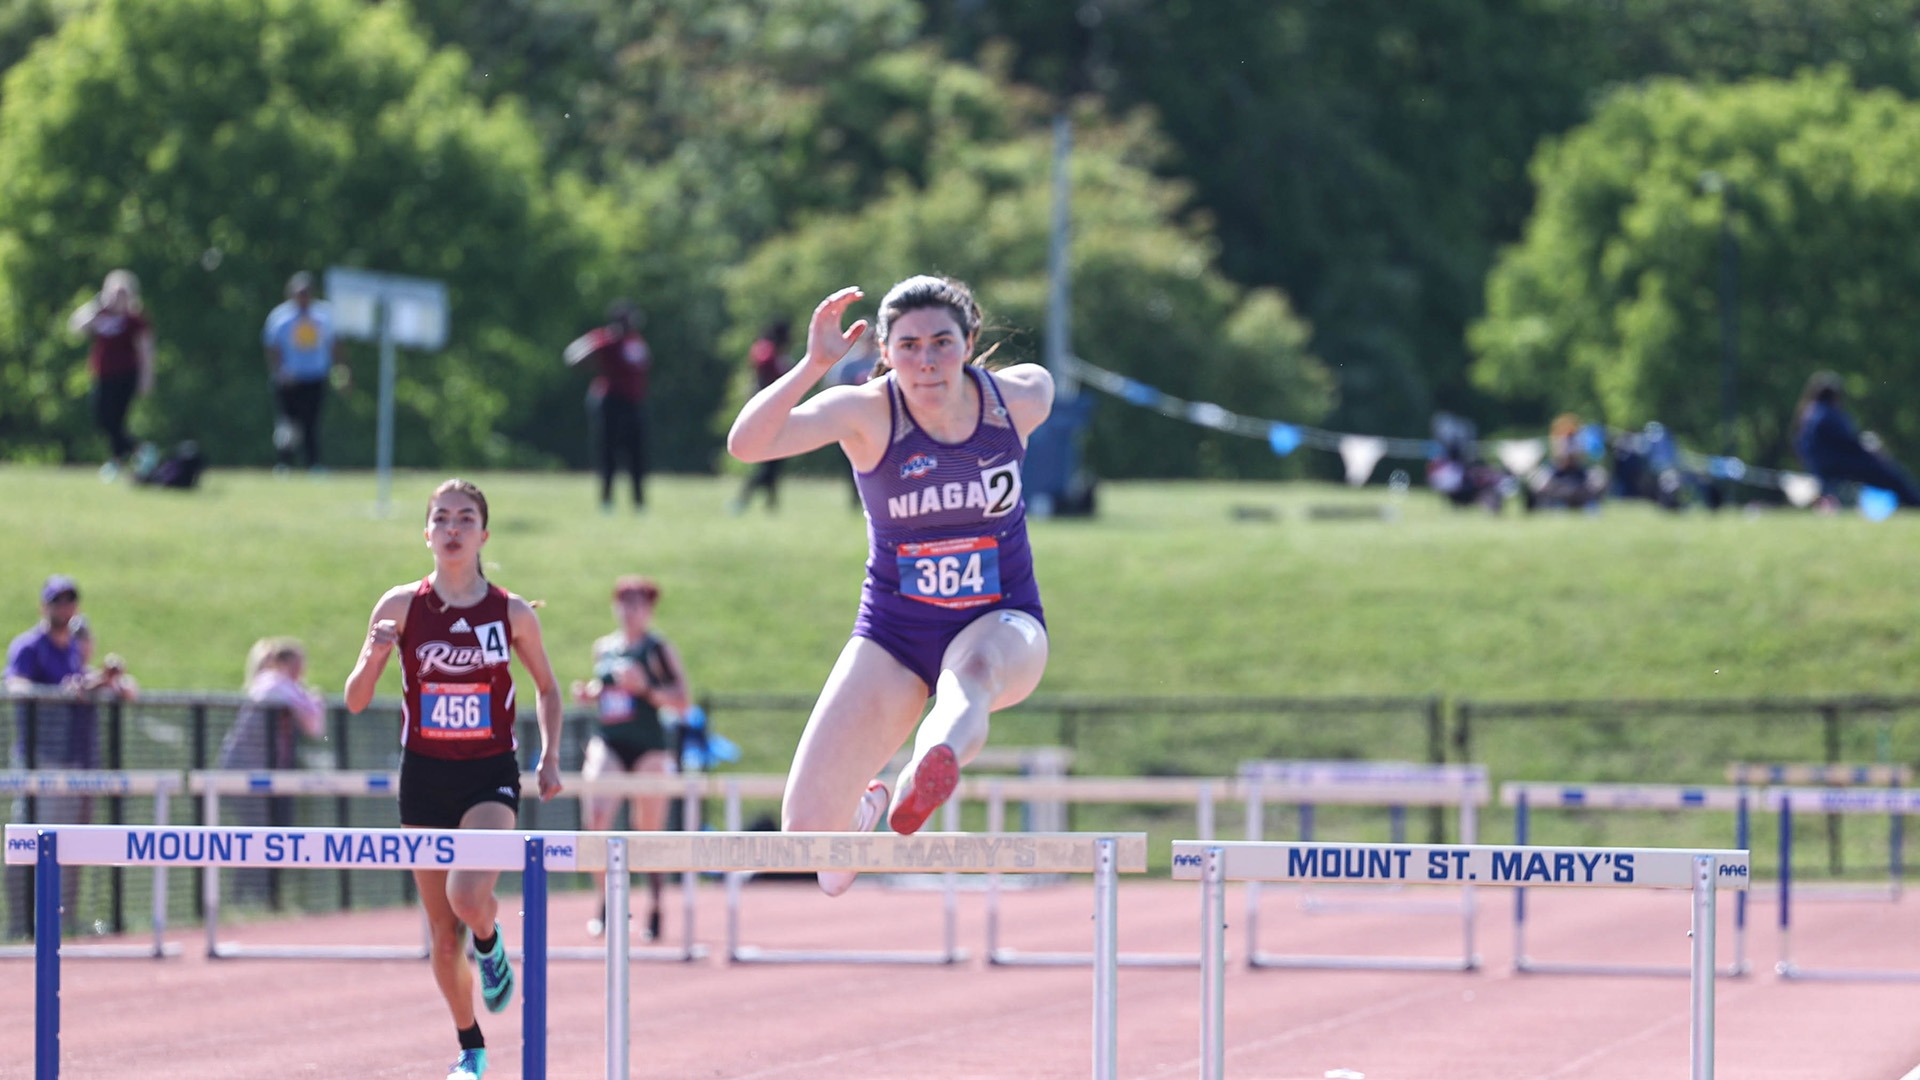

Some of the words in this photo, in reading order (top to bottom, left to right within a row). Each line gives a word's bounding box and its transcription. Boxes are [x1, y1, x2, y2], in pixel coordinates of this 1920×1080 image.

[888, 481, 986, 519] NIAGA
[990, 470, 1013, 514] 2
[915, 552, 984, 597] 364
[416, 640, 486, 677] RIDE
[487, 626, 503, 657] 4
[431, 694, 481, 728] 456
[127, 831, 252, 862] MOUNT
[265, 832, 310, 863] ST.
[324, 834, 455, 864] MARY'S
[691, 837, 815, 867] MOUNT
[893, 837, 1035, 867] MARY'S
[1288, 847, 1412, 879] MOUNT
[1427, 849, 1477, 881] ST.
[1491, 851, 1635, 883] MARY'S
